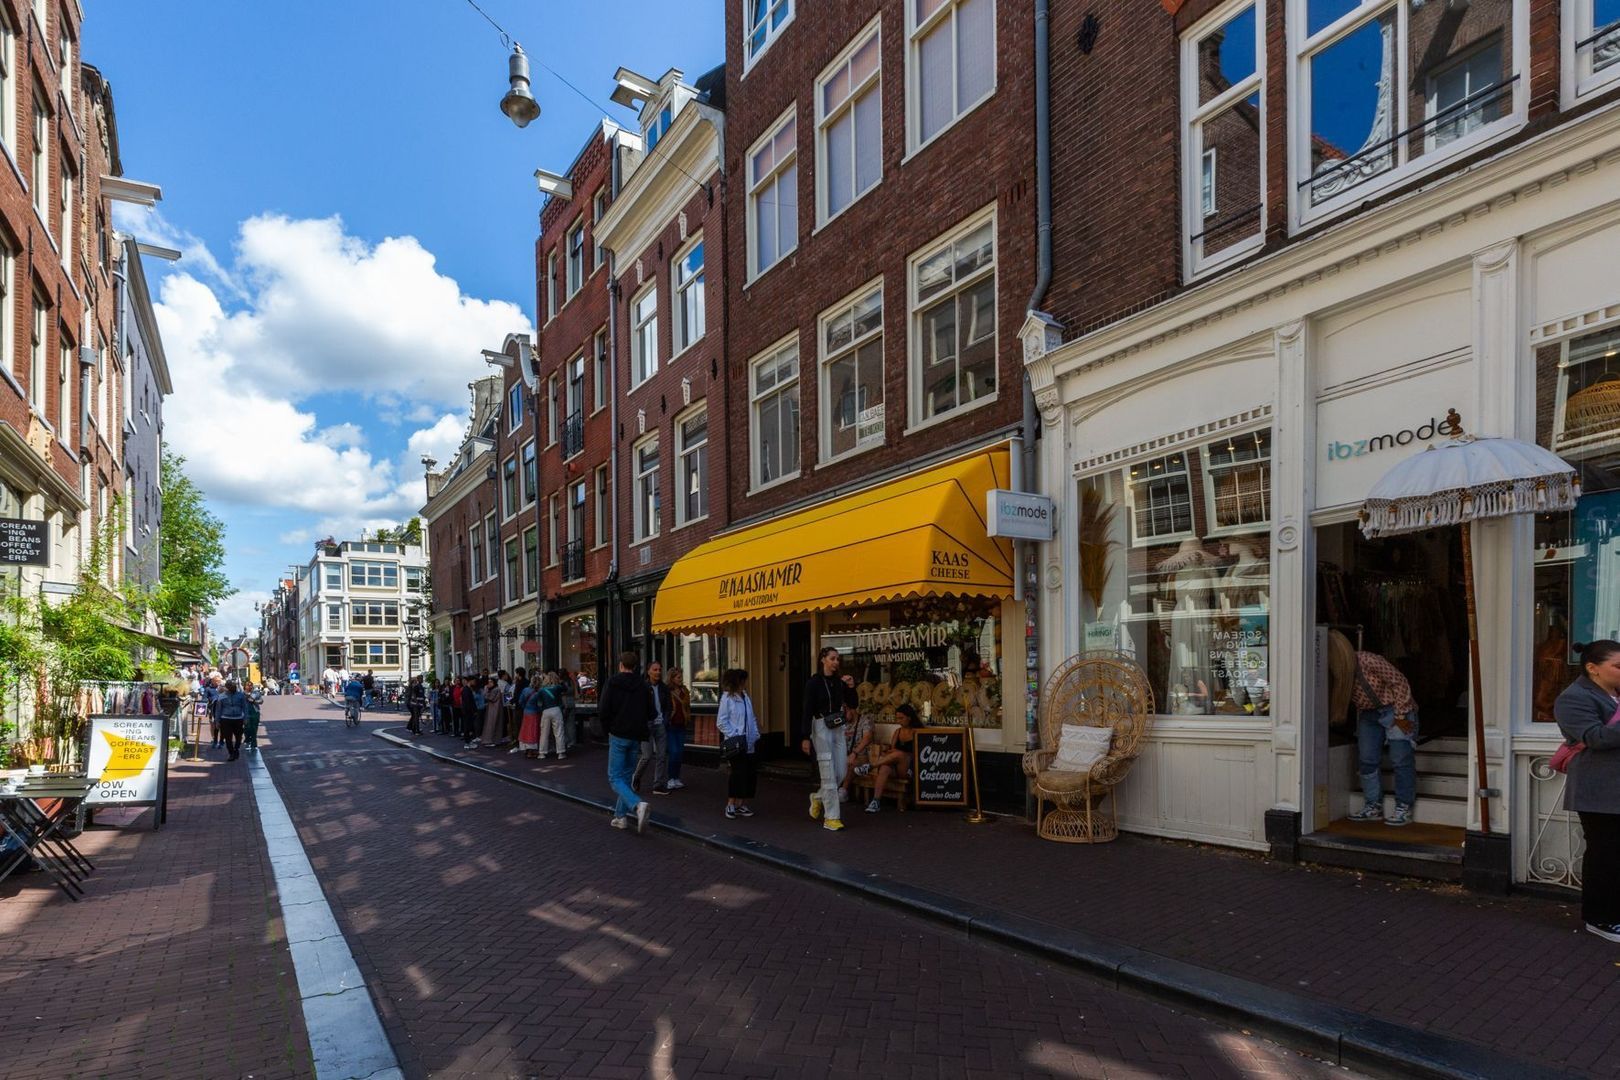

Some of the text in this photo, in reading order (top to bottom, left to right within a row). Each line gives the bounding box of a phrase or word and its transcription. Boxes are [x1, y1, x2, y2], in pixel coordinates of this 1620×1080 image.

[1327, 417, 1453, 461] ibzmode
[1000, 500, 1048, 519] ibzmode
[1, 541, 32, 549] OFFEE
[932, 551, 969, 566] KAAS
[729, 562, 802, 598] KAASKAMER
[931, 567, 970, 579] CHEESE
[744, 593, 779, 607] AMSTERDAM
[920, 745, 962, 766] Capra
[100, 790, 137, 798] OPEN
